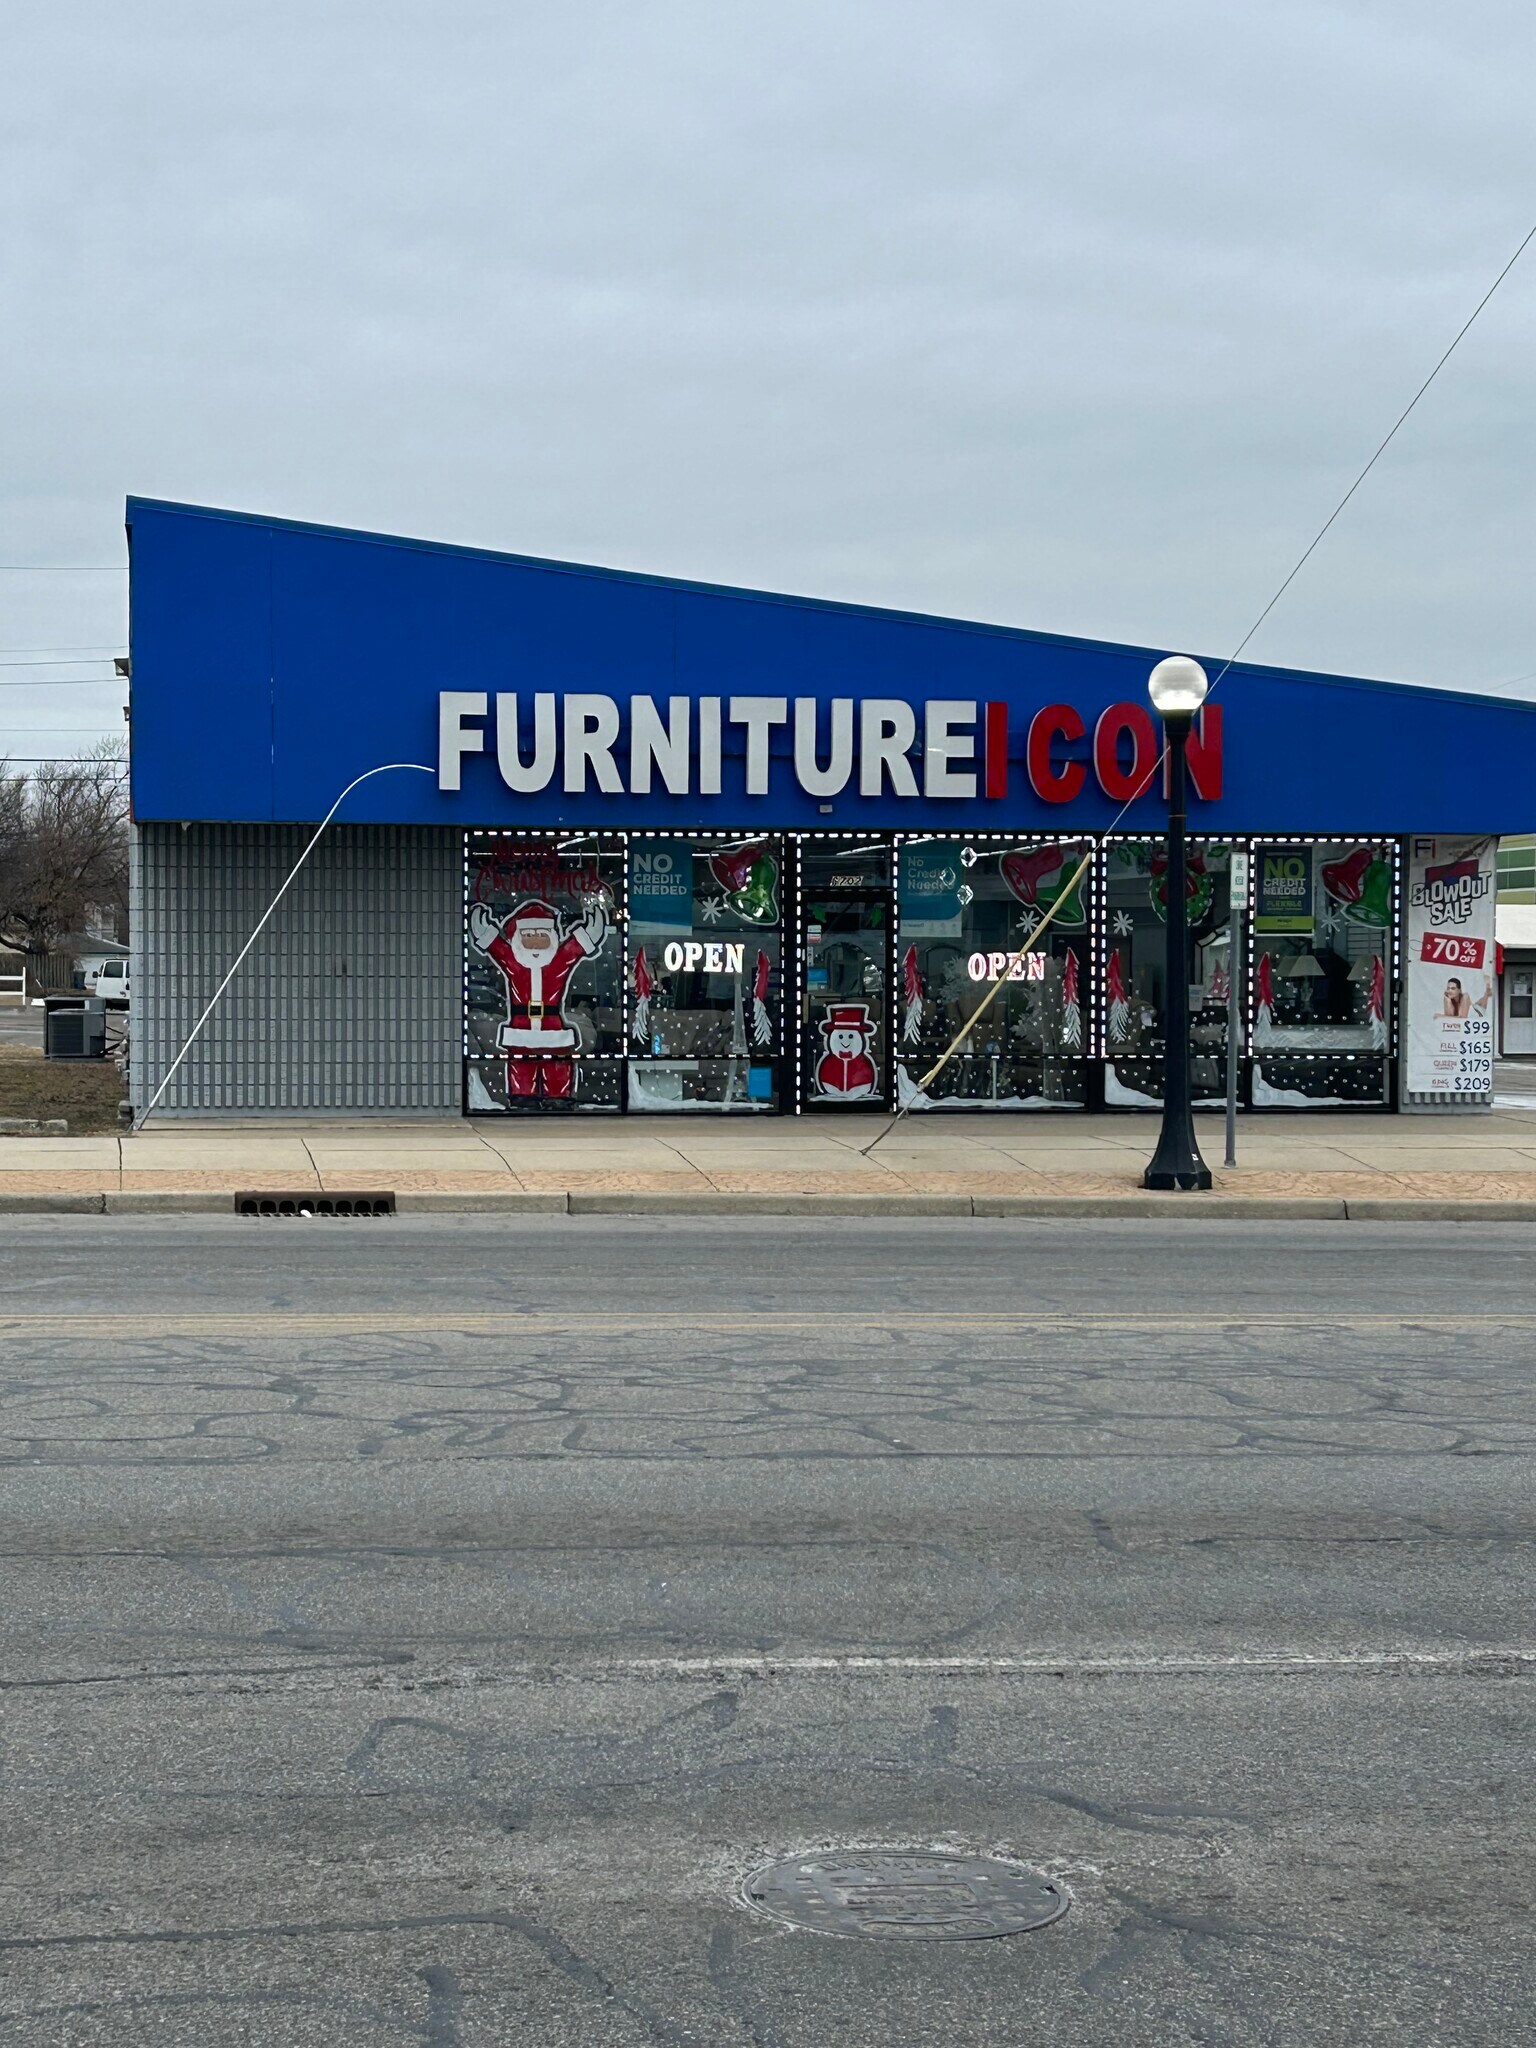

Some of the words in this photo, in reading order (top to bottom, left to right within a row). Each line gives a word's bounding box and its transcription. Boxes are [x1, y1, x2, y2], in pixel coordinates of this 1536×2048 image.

[439, 691, 976, 797] FURNITURE
[985, 701, 1223, 803] ICON
[634, 853, 673, 873] NO
[908, 857, 924, 867] No
[1264, 857, 1305, 880] NO
[633, 873, 682, 884] CREDIT
[1263, 878, 1306, 887] CREDIT
[633, 885, 687, 895] NEEDED
[1263, 887, 1306, 896] NEEDED
[1411, 870, 1492, 907] BLOWOUT
[1430, 897, 1472, 926] SALE
[664, 941, 745, 973] OPEN
[1460, 955, 1477, 963] OFF
[968, 951, 1047, 981] OPEN
[1464, 1020, 1490, 1034] $99
[1459, 1041, 1491, 1055] $165
[1460, 1058, 1490, 1072] $179
[1454, 1076, 1491, 1090] $209
